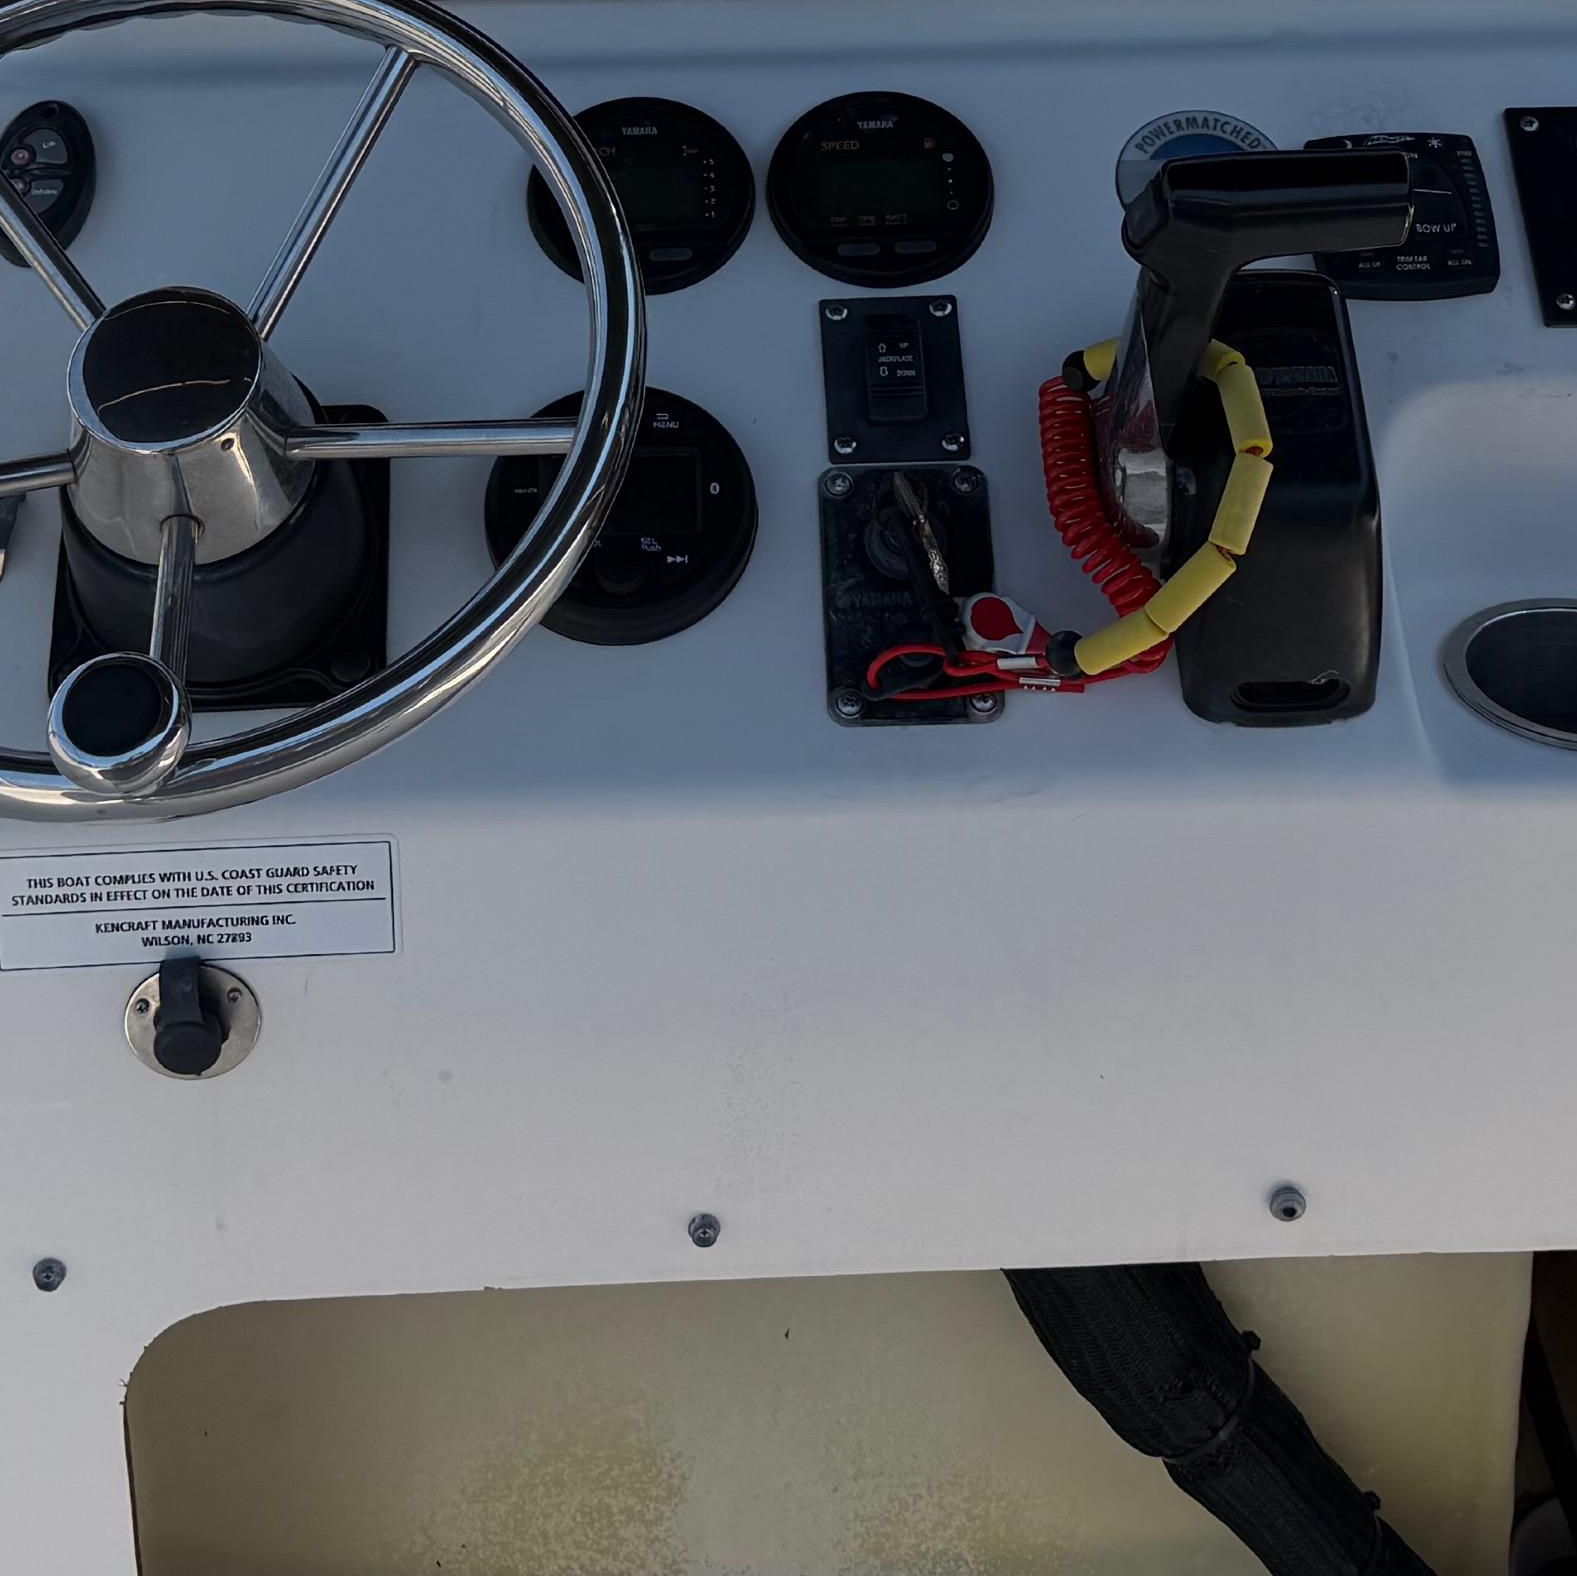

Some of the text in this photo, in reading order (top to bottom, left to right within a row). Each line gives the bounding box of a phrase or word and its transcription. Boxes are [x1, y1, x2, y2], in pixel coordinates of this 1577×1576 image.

[621, 126, 658, 135] YAMAHA
[857, 120, 894, 129] YAMAHA
[1135, 117, 1261, 154] POWERMATCHED
[820, 140, 860, 151] SPEED
[1416, 222, 1457, 233] BOW UP
[26, 864, 358, 889] THIS BOAT COMPLIES WITH U.S. COAST GUARD SAFETY
[11, 880, 375, 906] STANDARDS IN EFFECT ON THE DATE OF THIS CERTIFICATION
[95, 920, 159, 934] KENCRAFT
[161, 915, 270, 930] MANUFACTURING
[141, 934, 193, 947] WILSON,
[196, 933, 214, 945] NC
